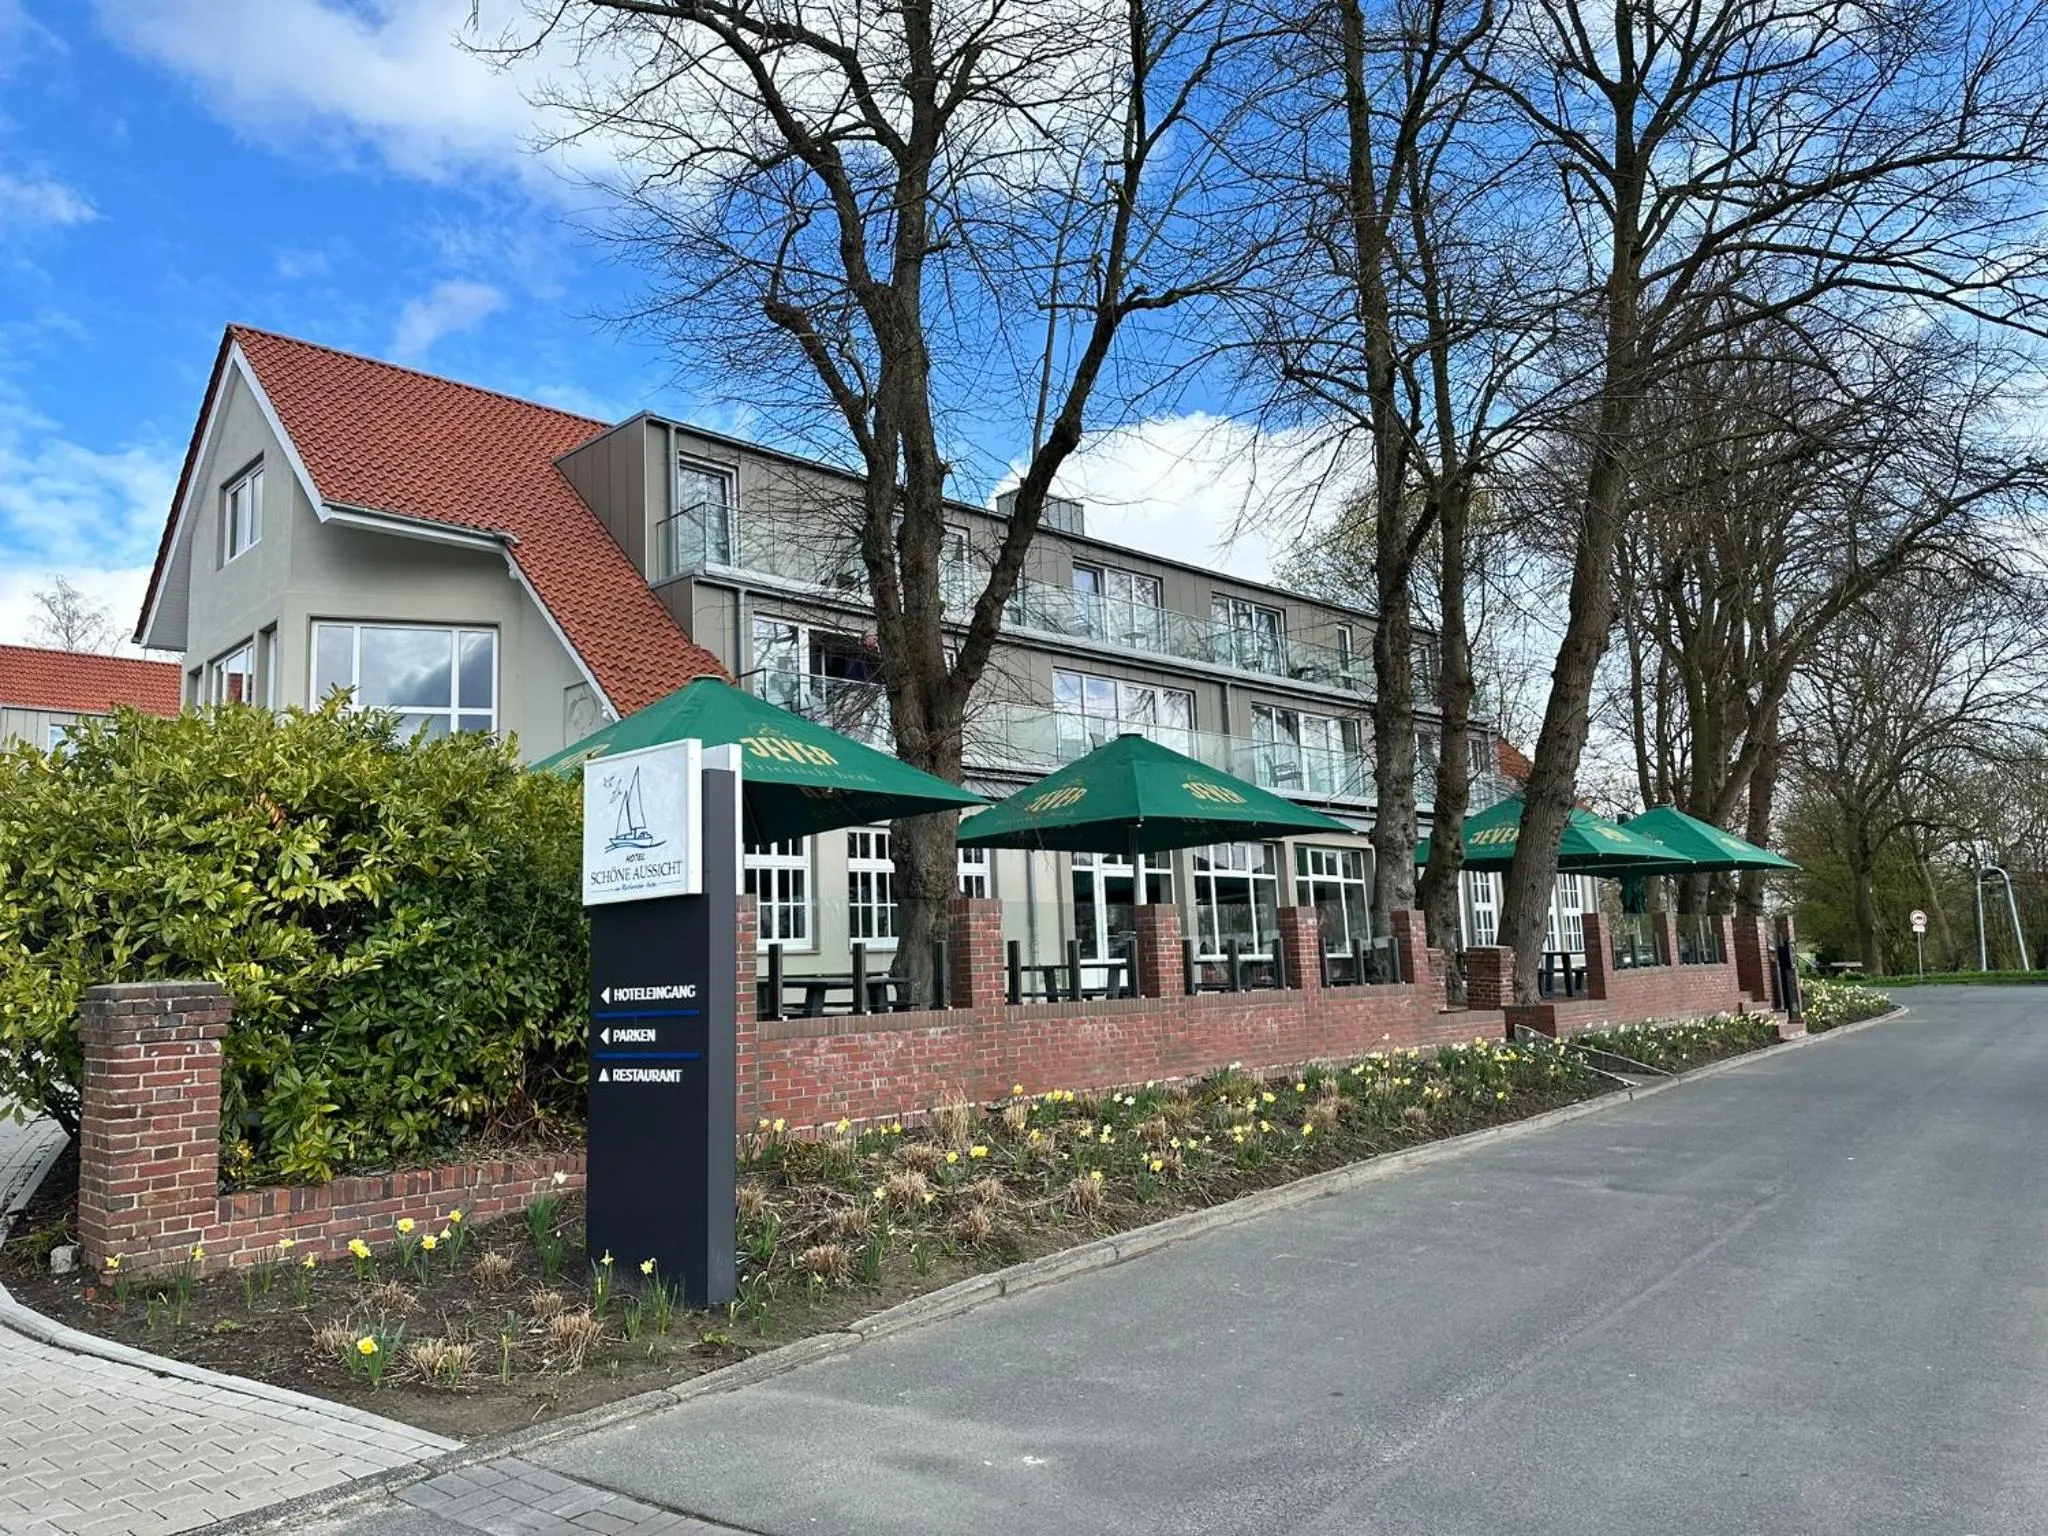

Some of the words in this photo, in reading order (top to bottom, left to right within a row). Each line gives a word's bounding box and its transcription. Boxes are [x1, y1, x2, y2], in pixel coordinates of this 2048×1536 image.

[739, 737, 839, 765] JEVER
[1182, 782, 1247, 804] JEVER
[590, 866, 631, 885] SCHÖNE
[632, 861, 682, 880] AUSSICHT
[613, 984, 697, 1002] HOTELEINGANG
[612, 1028, 656, 1043] PARKEN
[612, 1068, 683, 1083] RESTAURANT
